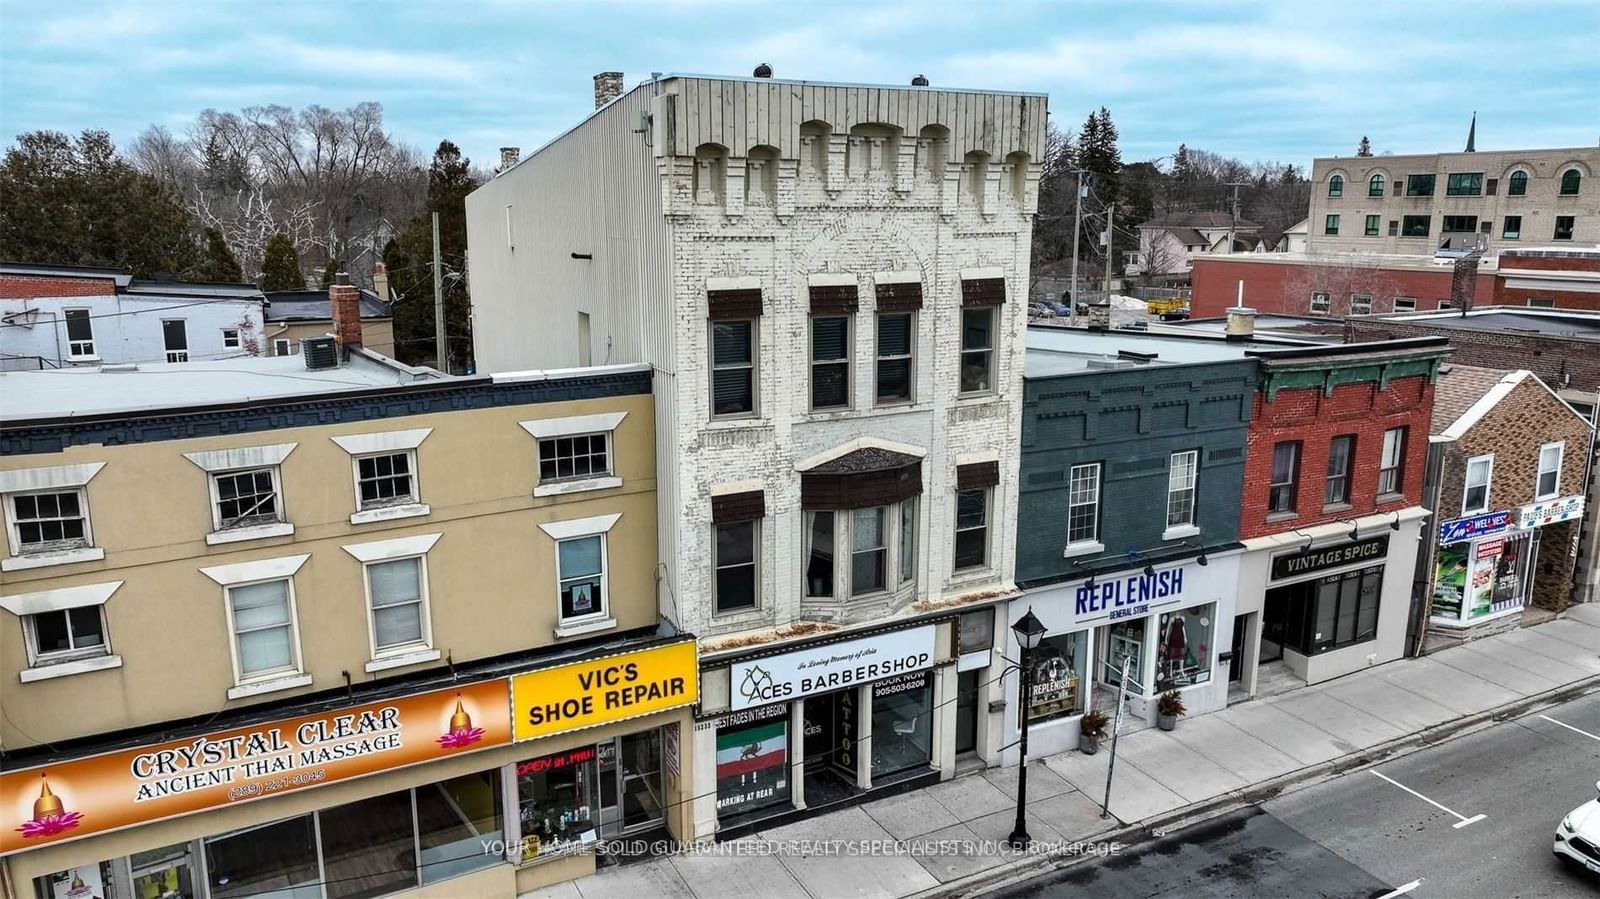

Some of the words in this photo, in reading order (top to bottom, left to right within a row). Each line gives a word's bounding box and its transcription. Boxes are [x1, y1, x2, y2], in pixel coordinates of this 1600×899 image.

[1288, 550, 1341, 572] VINTAGE
[1344, 542, 1379, 560] SPICE
[1075, 568, 1183, 615] REPLENISH
[1109, 607, 1132, 620] GENERAL
[1133, 604, 1149, 615] STORE
[801, 653, 929, 693] BARBERSHOP
[808, 657, 830, 670] Loving
[830, 652, 855, 664] Memory
[578, 663, 638, 691] VIC'S
[1033, 678, 1071, 696] REPLENISH
[529, 696, 593, 726] SHOE
[605, 677, 684, 710] REPAIR
[730, 711, 748, 726] FADES
[748, 710, 755, 722] IN
[755, 707, 766, 720] THE
[766, 703, 787, 718] REGION
[132, 730, 288, 778] CRYSTAL
[298, 708, 399, 745] CLEAR
[842, 691, 853, 766] ATTOO
[136, 768, 235, 800] ANCIENT
[240, 755, 293, 779] THAI
[300, 734, 400, 767] MASSAGE
[514, 756, 553, 776] OPEN
[228, 783, 264, 800] (289)
[266, 770, 326, 790] 221-3045
[746, 792, 755, 801] AT
[756, 787, 773, 799] REAR
